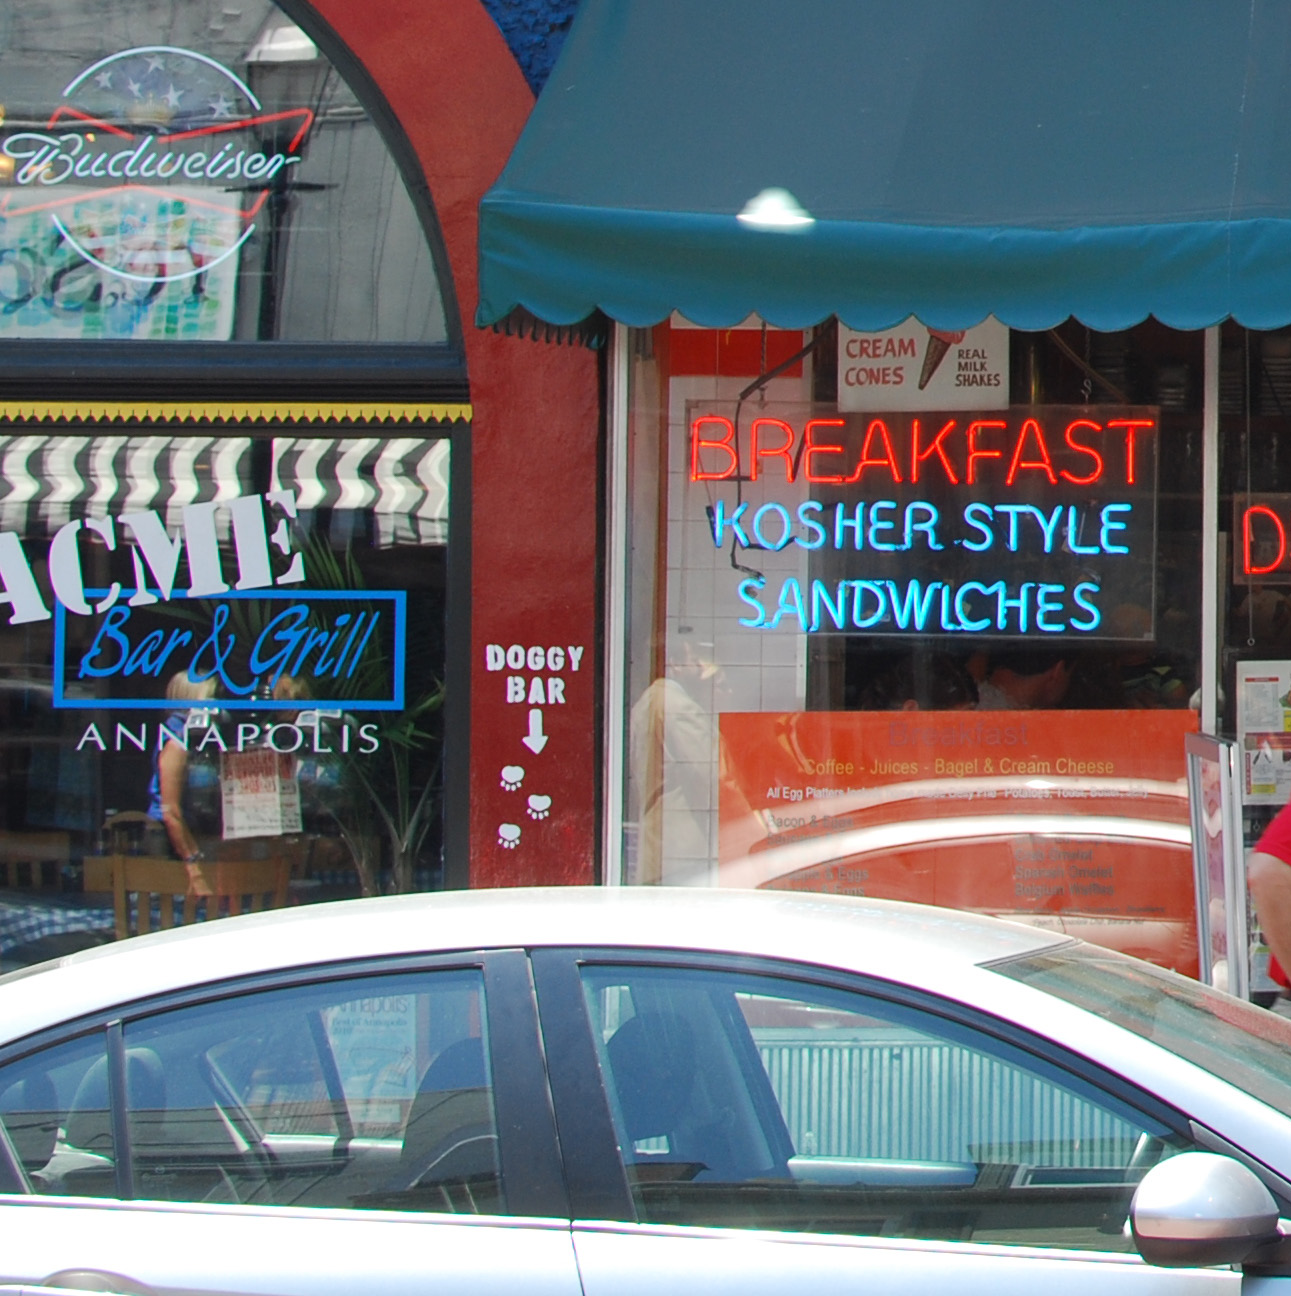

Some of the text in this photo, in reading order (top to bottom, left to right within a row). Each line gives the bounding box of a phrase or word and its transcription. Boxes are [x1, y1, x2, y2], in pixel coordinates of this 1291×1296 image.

[2, 133, 301, 184] Budweiser
[846, 338, 916, 359] CREAM
[958, 349, 987, 359] REAL
[845, 367, 904, 386] CONES
[958, 361, 987, 372] MILK
[955, 374, 1000, 387] SHAKES
[691, 418, 1155, 485] BREAKFAST
[711, 500, 1132, 554] KOSHER STYLE
[737, 577, 1101, 634] SANDWICHES
[79, 604, 380, 695] Bar & Grill
[486, 644, 584, 671] DOGGY
[507, 676, 566, 704] BAR
[76, 722, 380, 754] ANNAPOLIS
[888, 720, 1029, 747] Breakfast
[805, 758, 1114, 778] Coffee Juices Bagel & Cream Cheese
[783, 787, 803, 800] Egg
